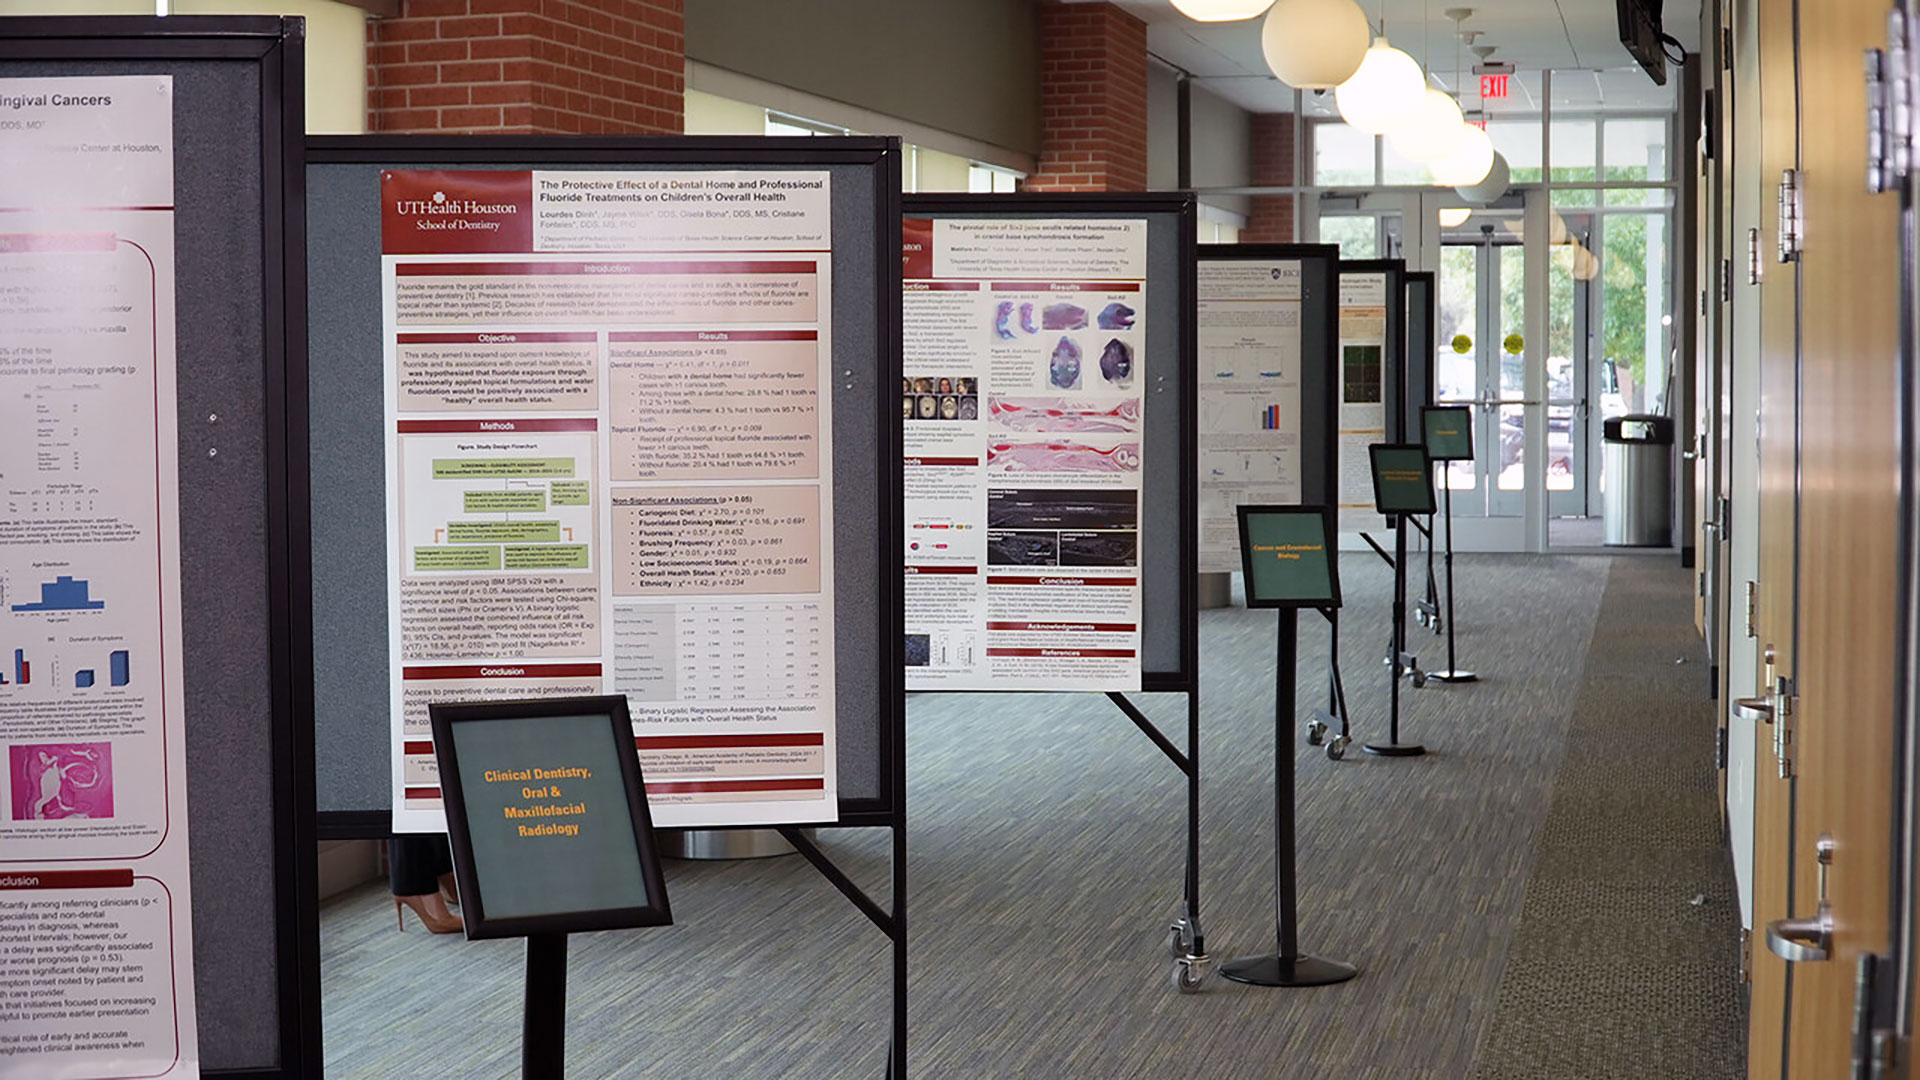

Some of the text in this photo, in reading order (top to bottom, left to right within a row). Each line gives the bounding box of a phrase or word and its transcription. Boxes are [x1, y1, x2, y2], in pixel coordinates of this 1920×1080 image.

[1480, 75, 1509, 98] EXIT
[52, 94, 111, 106] Cancers
[123, 144, 162, 152] Houston,
[540, 180, 559, 189] The
[562, 180, 613, 189] Protective
[616, 180, 647, 189] Effect
[650, 180, 659, 189] of
[670, 180, 703, 189] Dental
[706, 180, 735, 189] Home
[738, 180, 757, 189] and
[760, 180, 823, 189] Professional
[540, 193, 582, 201] Fluoride
[585, 193, 641, 201] Treatments
[715, 192, 750, 201] Overall
[753, 192, 786, 201] Health
[464, 201, 517, 214] Houston
[540, 210, 573, 218] Lourdes
[417, 220, 500, 231] School of Dentistry
[584, 264, 631, 273] Introduction
[478, 334, 516, 343] Objective
[425, 369, 473, 378] hypothesized
[522, 370, 556, 378] exposure
[558, 368, 587, 377] through
[479, 422, 515, 430] Methods
[1039, 577, 1084, 585] Conclusion
[480, 667, 525, 676] Conclusion
[639, 707, 660, 716] Binary
[662, 707, 688, 716] Logistic
[690, 706, 728, 715] Regression
[729, 705, 763, 714] Assessing
[778, 704, 816, 712] Association
[484, 767, 592, 782] Clinical Dentistry,
[522, 785, 561, 799] Oral &
[504, 803, 586, 818] Maxillofacial
[518, 823, 579, 837] Radiology
[30, 897, 139, 911] among referring clinicians
[41, 911, 57, 919] and
[28, 923, 35, 931] in
[82, 921, 119, 929] whereas
[11, 945, 34, 956] delay
[56, 943, 104, 955] significantly
[107, 941, 153, 951] associated
[37, 954, 78, 966] prognosis
[33, 966, 74, 977] significant
[77, 965, 100, 976] delay
[102, 967, 120, 975] may
[122, 964, 143, 972] stem
[33, 975, 143, 987] onset noted by patient and
[5, 1000, 21, 1008] that
[23, 999, 62, 1008] initiatives
[64, 998, 98, 1007] focused
[112, 996, 156, 1008] increasing
[22, 1007, 149, 1021] to promote earlier presentation
[22, 1030, 128, 1043] role of early and accurate
[43, 1042, 72, 1051] clinical
[119, 1040, 144, 1049] when
